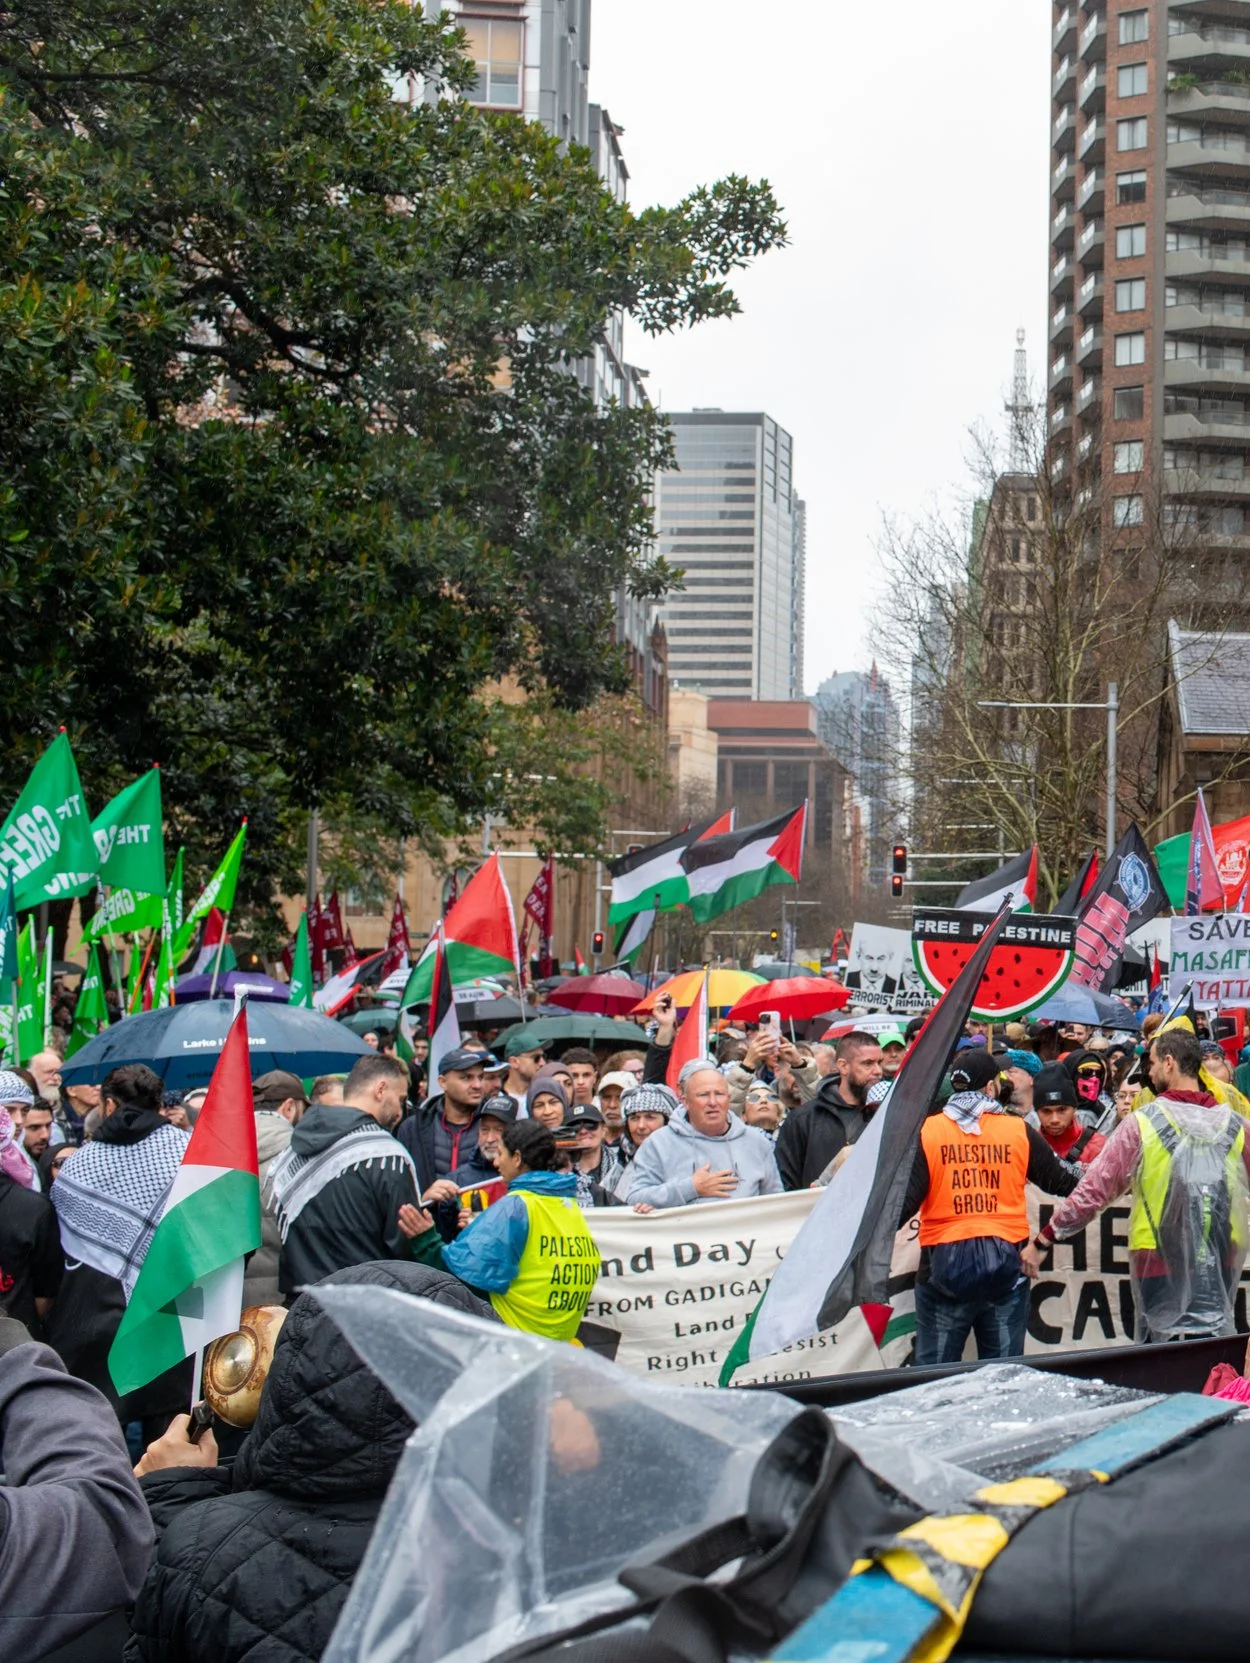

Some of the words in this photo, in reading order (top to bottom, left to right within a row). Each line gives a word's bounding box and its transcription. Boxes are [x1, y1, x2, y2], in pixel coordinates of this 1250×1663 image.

[914, 920, 960, 935] FREE
[972, 923, 1071, 944] PESTINE
[849, 989, 894, 1006] ERRORIST
[896, 998, 935, 1008] RIMINAL
[940, 1143, 1012, 1166] PALESTINE
[951, 1168, 1001, 1190] ACTION
[540, 1235, 600, 1258] PALESTIN
[601, 1246, 655, 1278] nd
[673, 1239, 756, 1268] Day
[547, 1291, 593, 1312] GROU
[583, 1295, 654, 1318] FROM
[665, 1278, 771, 1306] GADIGA
[675, 1314, 735, 1338] Land
[647, 1349, 718, 1372] Right
